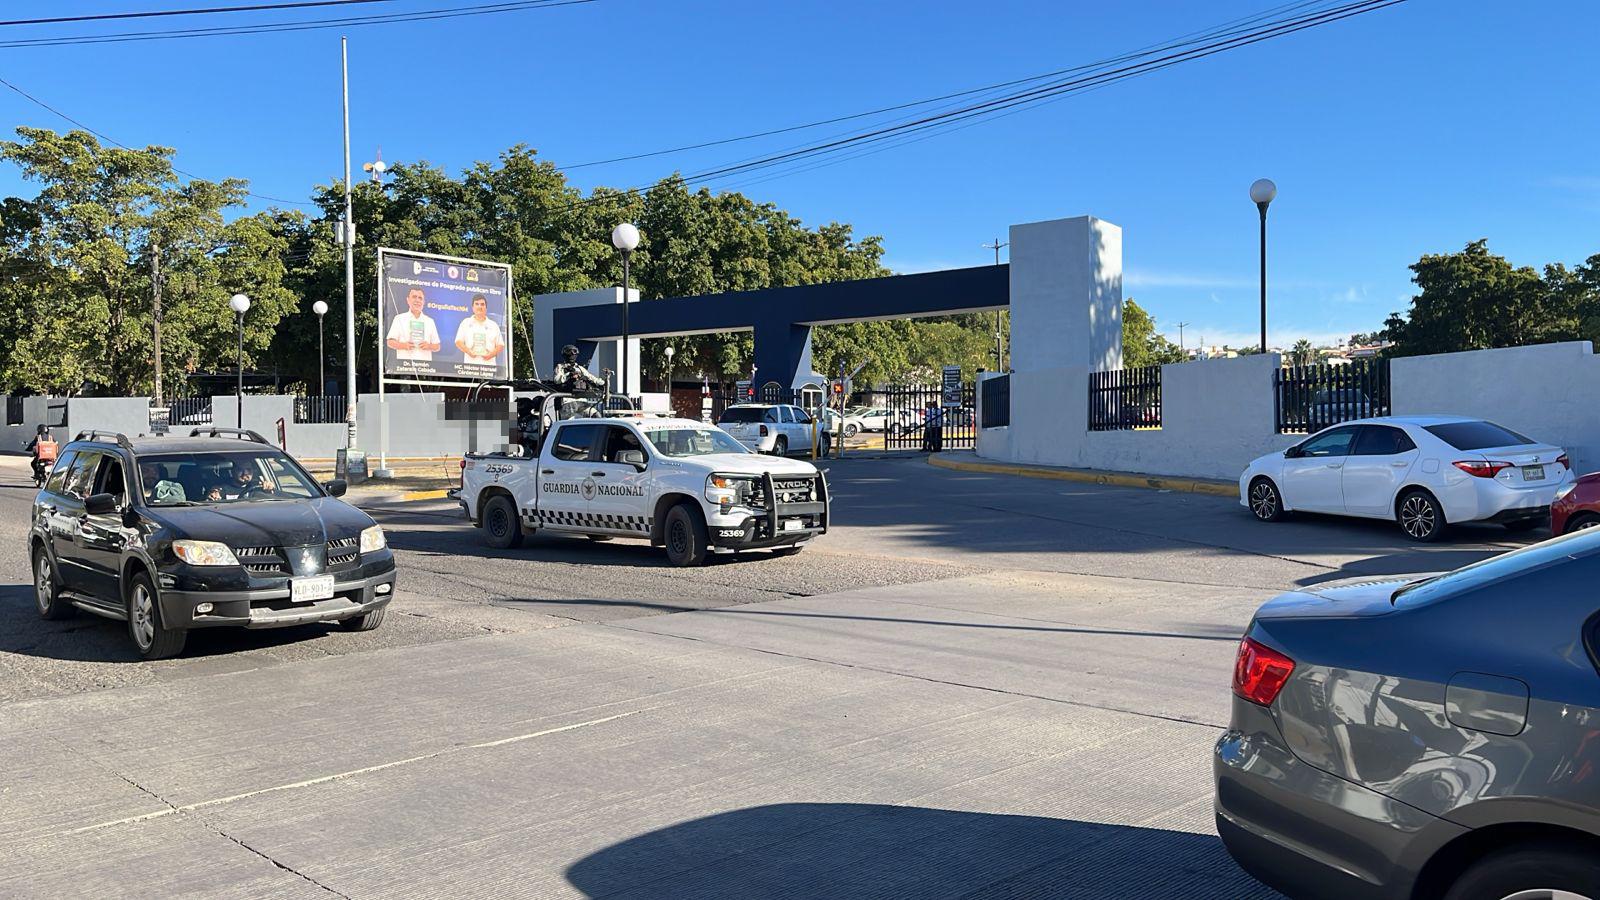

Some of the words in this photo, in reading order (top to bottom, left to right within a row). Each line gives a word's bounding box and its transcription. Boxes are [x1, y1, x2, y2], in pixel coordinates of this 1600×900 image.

[388, 277, 431, 287] Investigadores
[439, 282, 465, 291] Posgrado
[466, 286, 489, 294] publican
[485, 464, 513, 474] 25369
[543, 482, 580, 494] GUARDIA
[597, 485, 644, 497] NACIONAL
[719, 529, 745, 538] 25369
